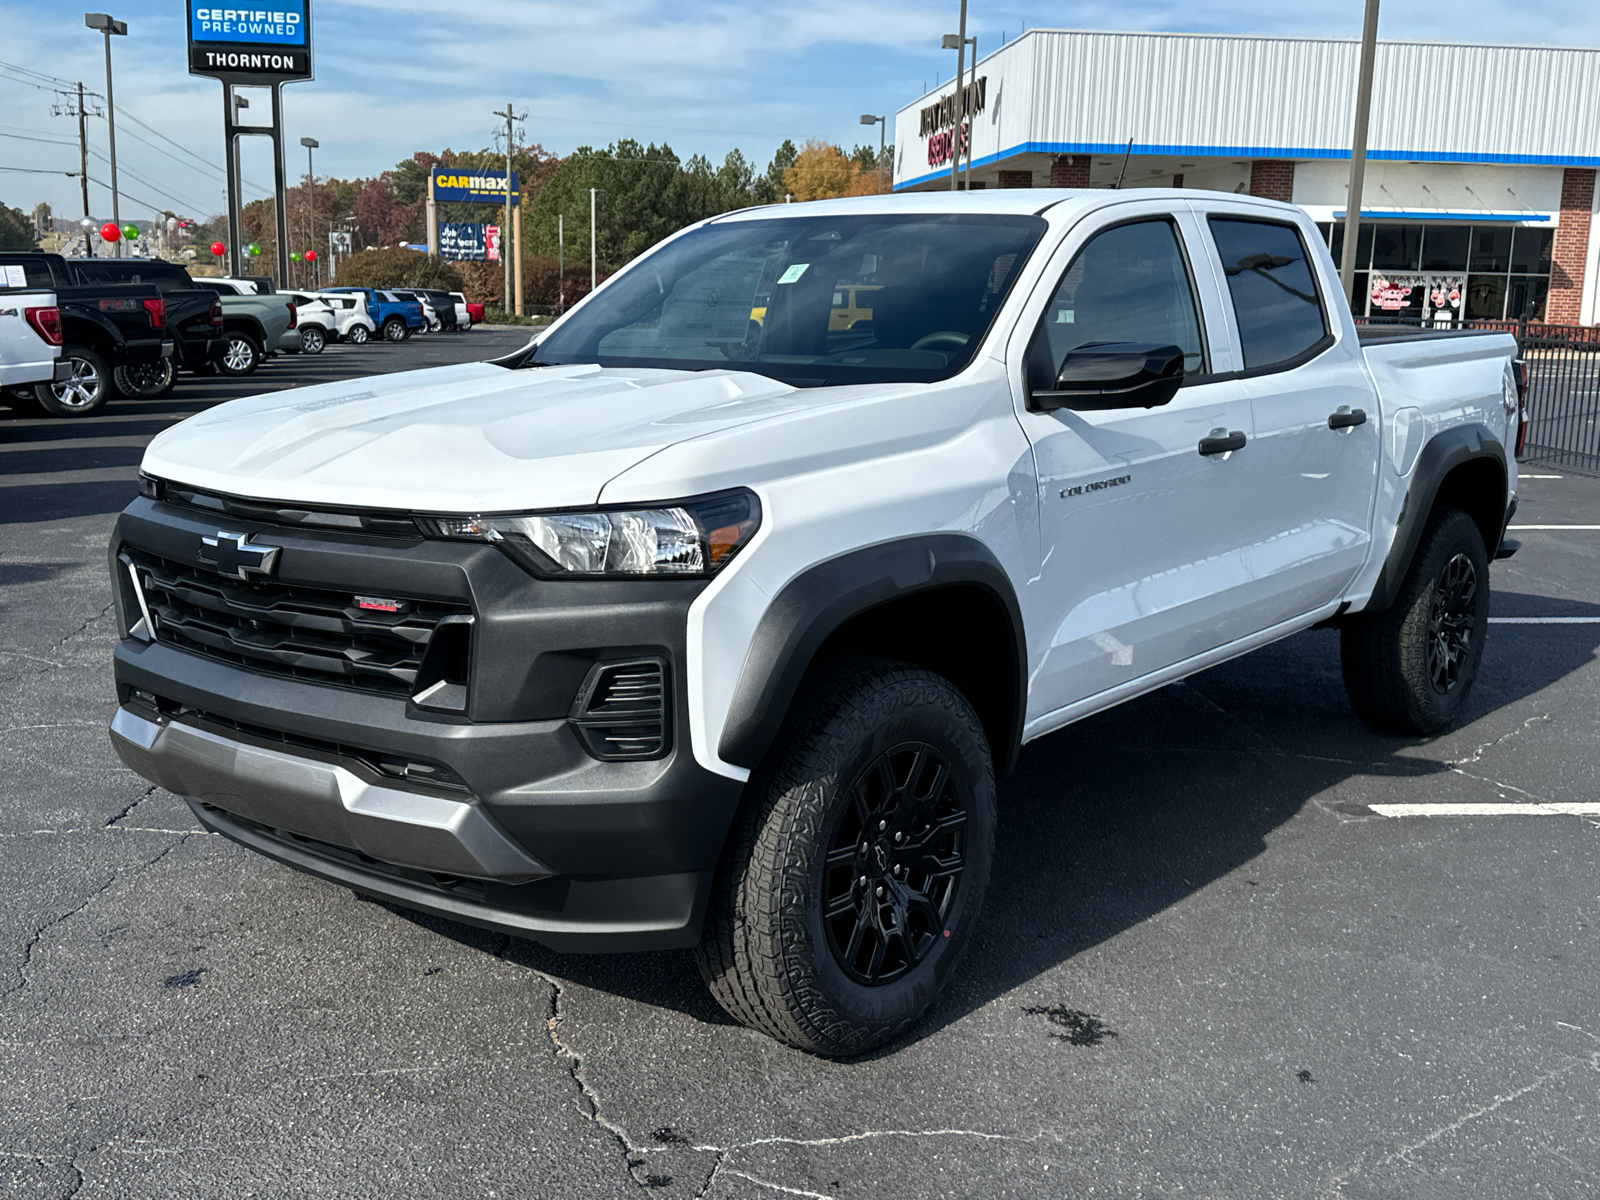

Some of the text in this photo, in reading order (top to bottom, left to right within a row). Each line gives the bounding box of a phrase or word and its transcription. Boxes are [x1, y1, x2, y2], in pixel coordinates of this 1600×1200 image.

[196, 8, 300, 24] CERTIFIED
[202, 21, 295, 36] PRE-OWNED
[205, 52, 293, 69] THORNTON
[945, 122, 967, 159] CAS
[1059, 475, 1132, 499] COLORADO
